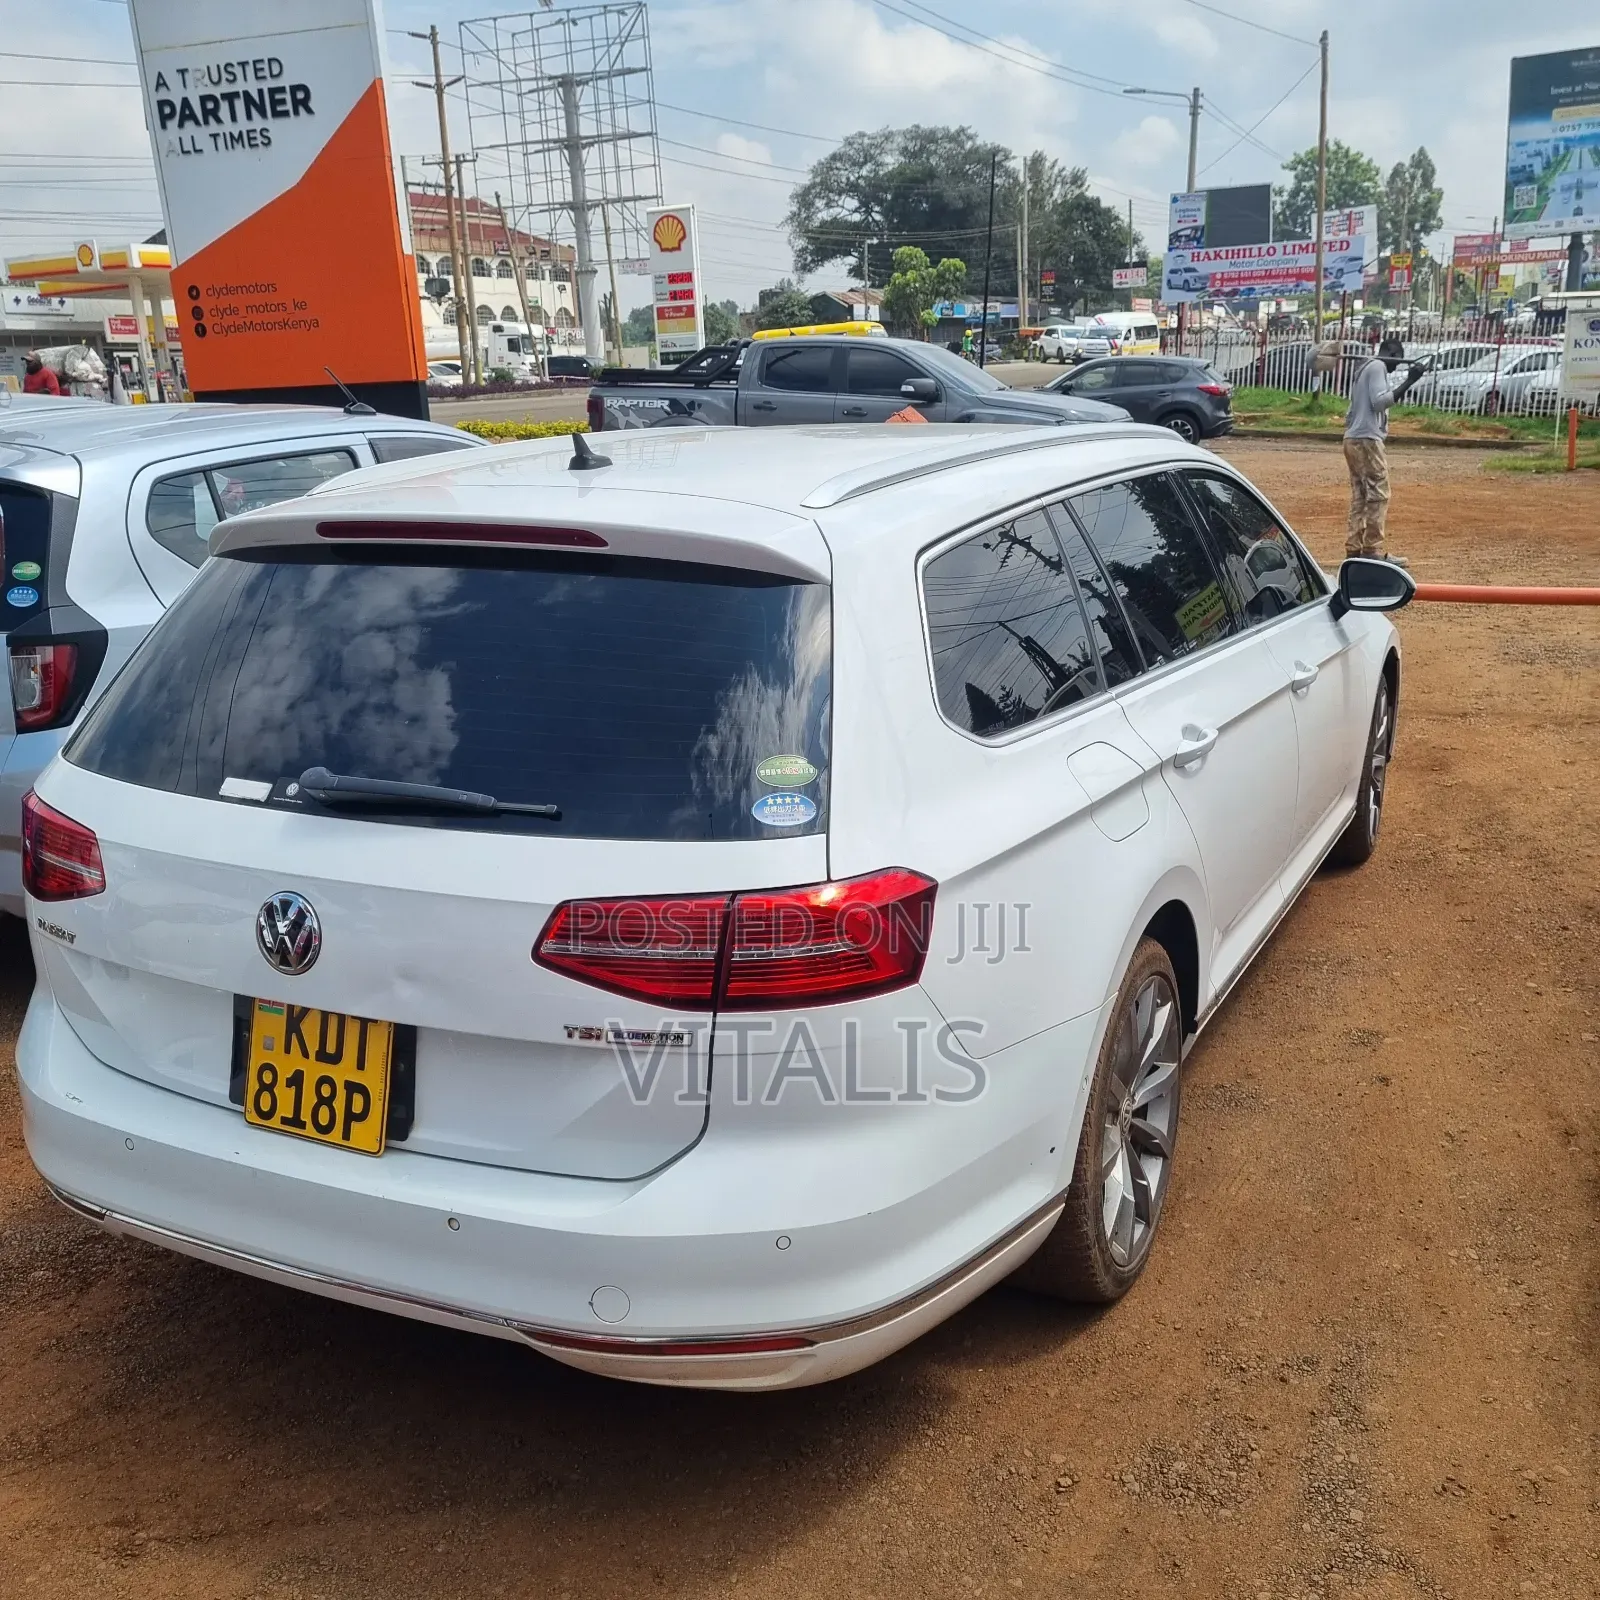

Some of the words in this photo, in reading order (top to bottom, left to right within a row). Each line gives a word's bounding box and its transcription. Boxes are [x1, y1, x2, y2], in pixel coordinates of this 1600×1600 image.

[155, 71, 170, 92] A
[176, 57, 283, 89] TRUSTED
[156, 83, 315, 130] PARTNER
[166, 136, 203, 157] ALL
[209, 128, 272, 152] TIMES
[1191, 246, 1277, 262] HAKIHILLO
[1228, 259, 1255, 269] Motor
[1256, 257, 1300, 268] Company
[205, 281, 278, 299] clydemotors
[209, 300, 308, 319] clyde_motors_ke
[212, 316, 320, 336] ClydeMotorsKenya
[604, 397, 672, 413] RAPTOR
[284, 1003, 378, 1071] KDT
[613, 1030, 684, 1042] BLUEMOTION
[254, 1062, 371, 1142] 818P
